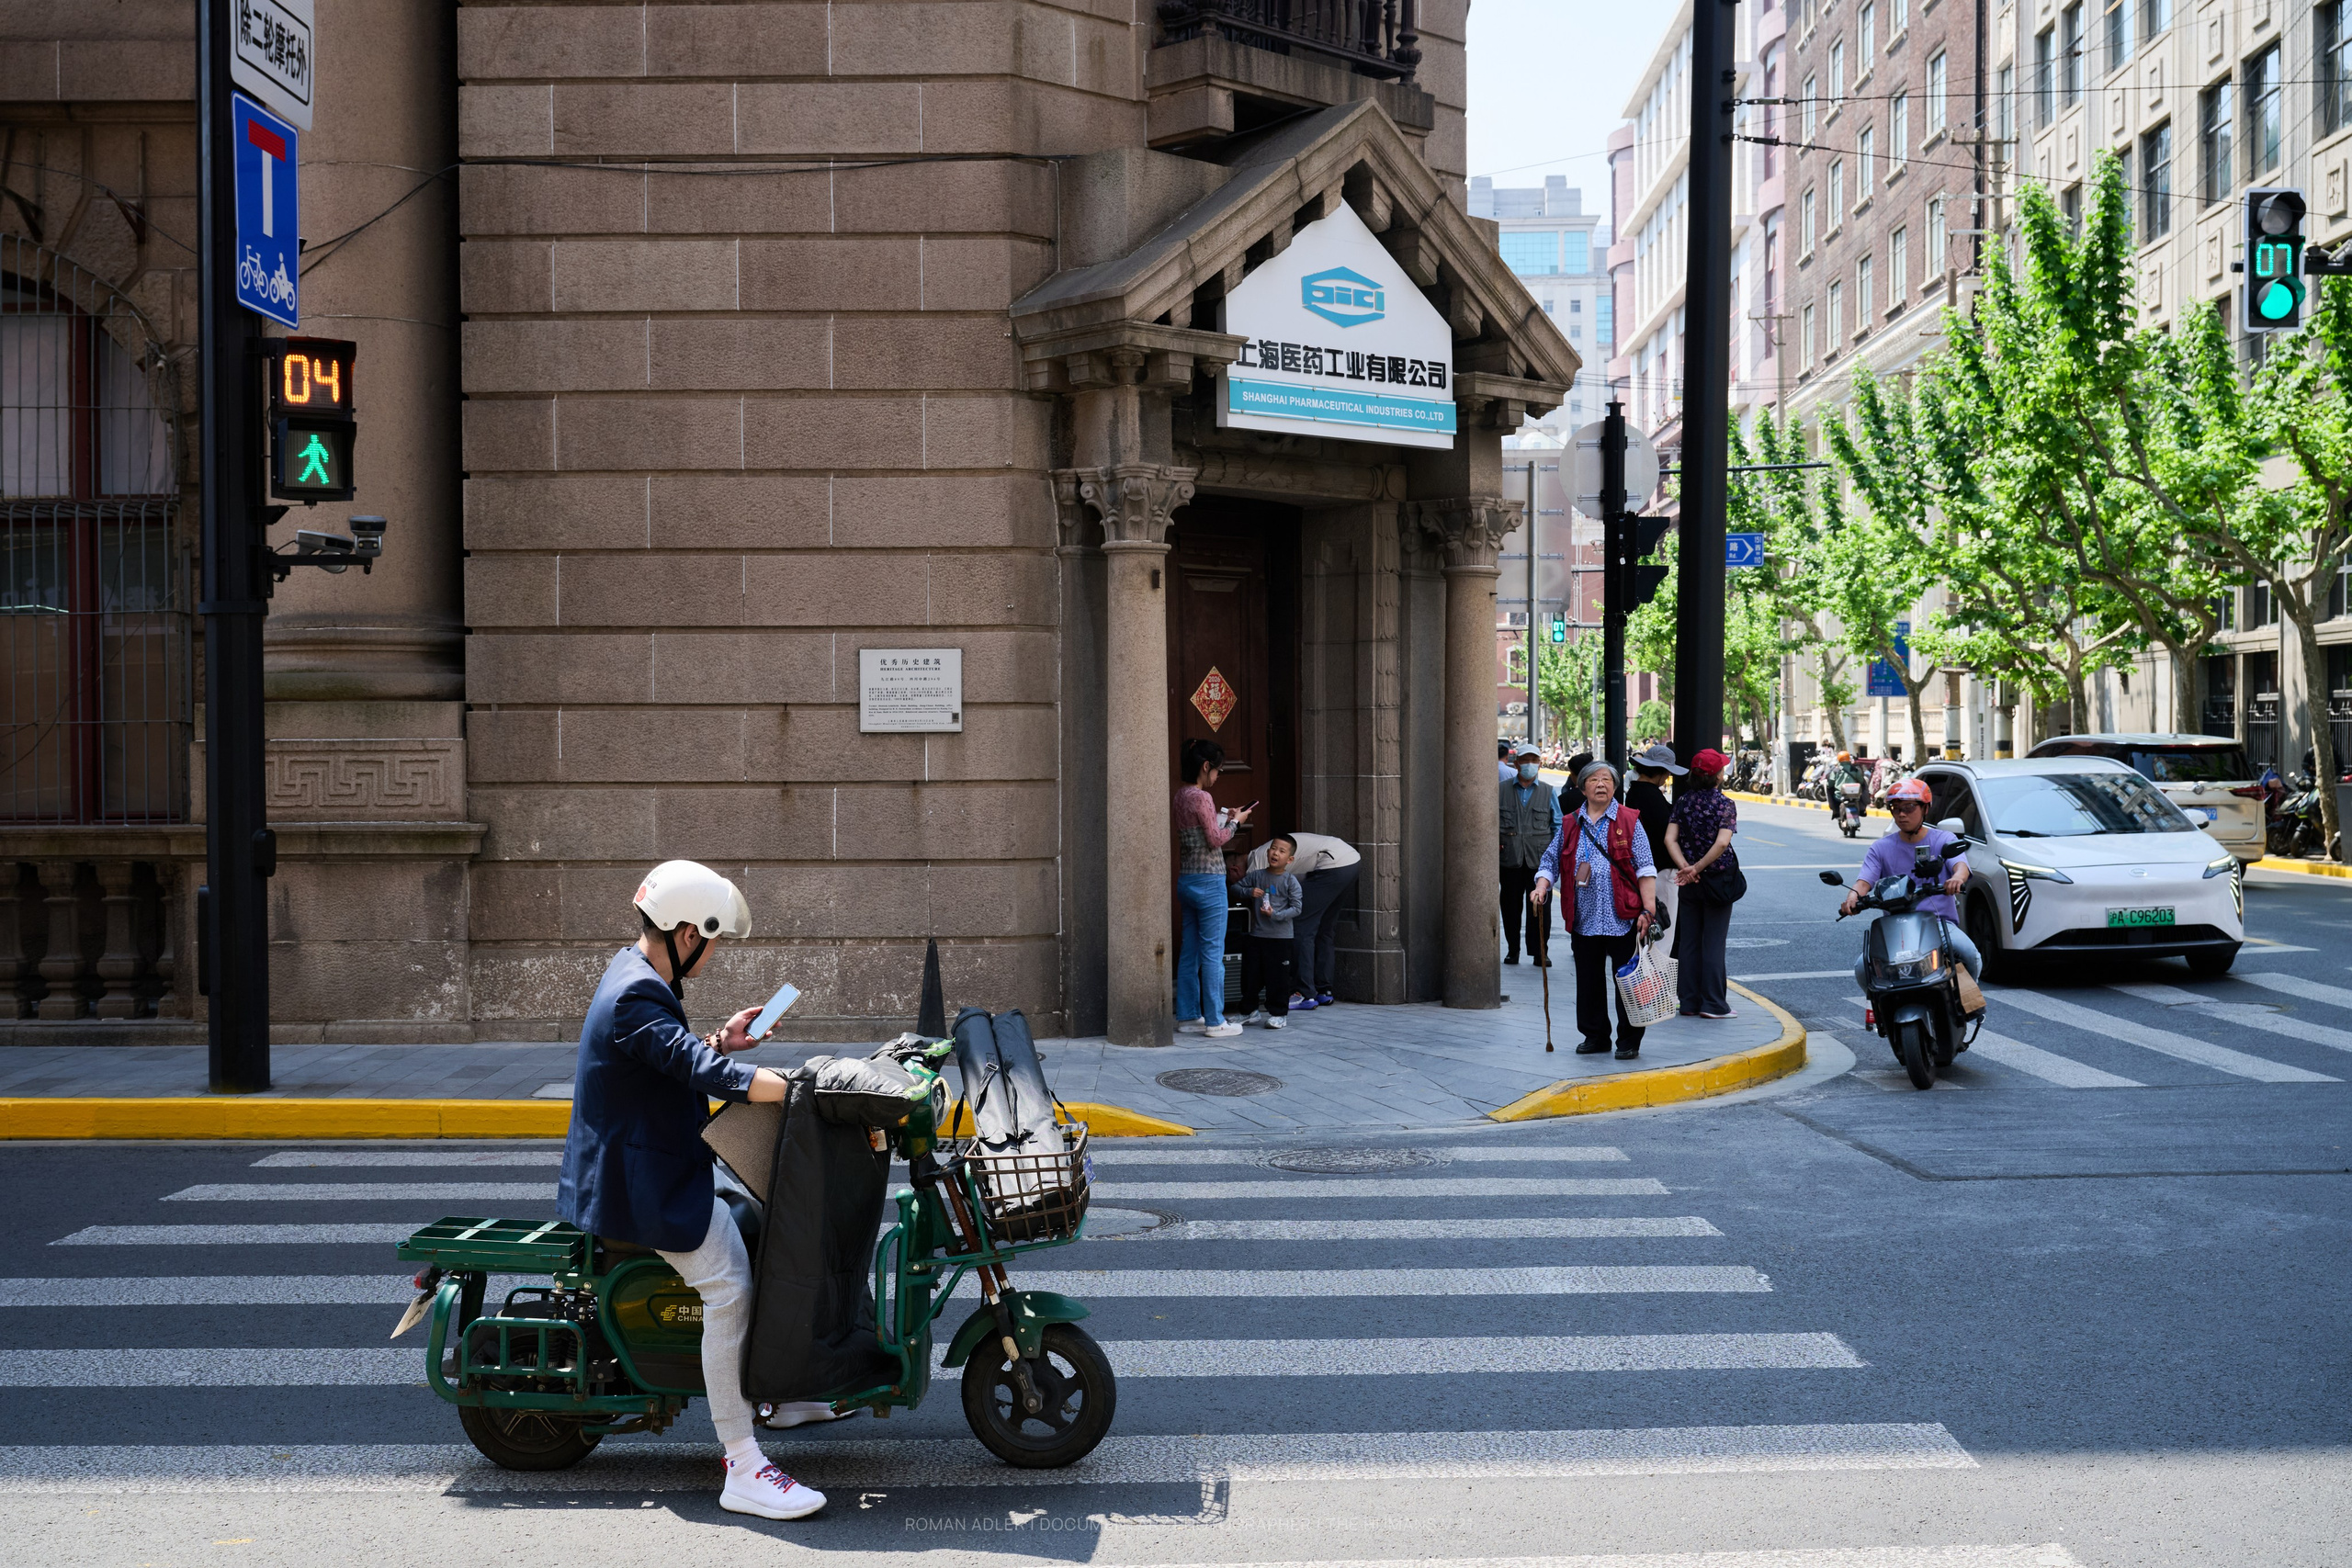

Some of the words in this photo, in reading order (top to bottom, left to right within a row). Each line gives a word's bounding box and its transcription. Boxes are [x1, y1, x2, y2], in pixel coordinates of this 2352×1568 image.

[240, 0, 306, 85] 除二轮摩托外
[2256, 243, 2292, 276] 07
[284, 354, 339, 403] 04
[1237, 339, 1447, 389] 上海医药工业有限公司
[1242, 390, 1288, 405] SHANGHAI
[1289, 396, 1364, 413] PHARMACEUTICAL
[1365, 404, 1413, 419] INDUSTRIES
[880, 658, 942, 666] 优秀历史建筑
[1208, 682, 1222, 700] 福
[678, 1305, 702, 1315] 中国
